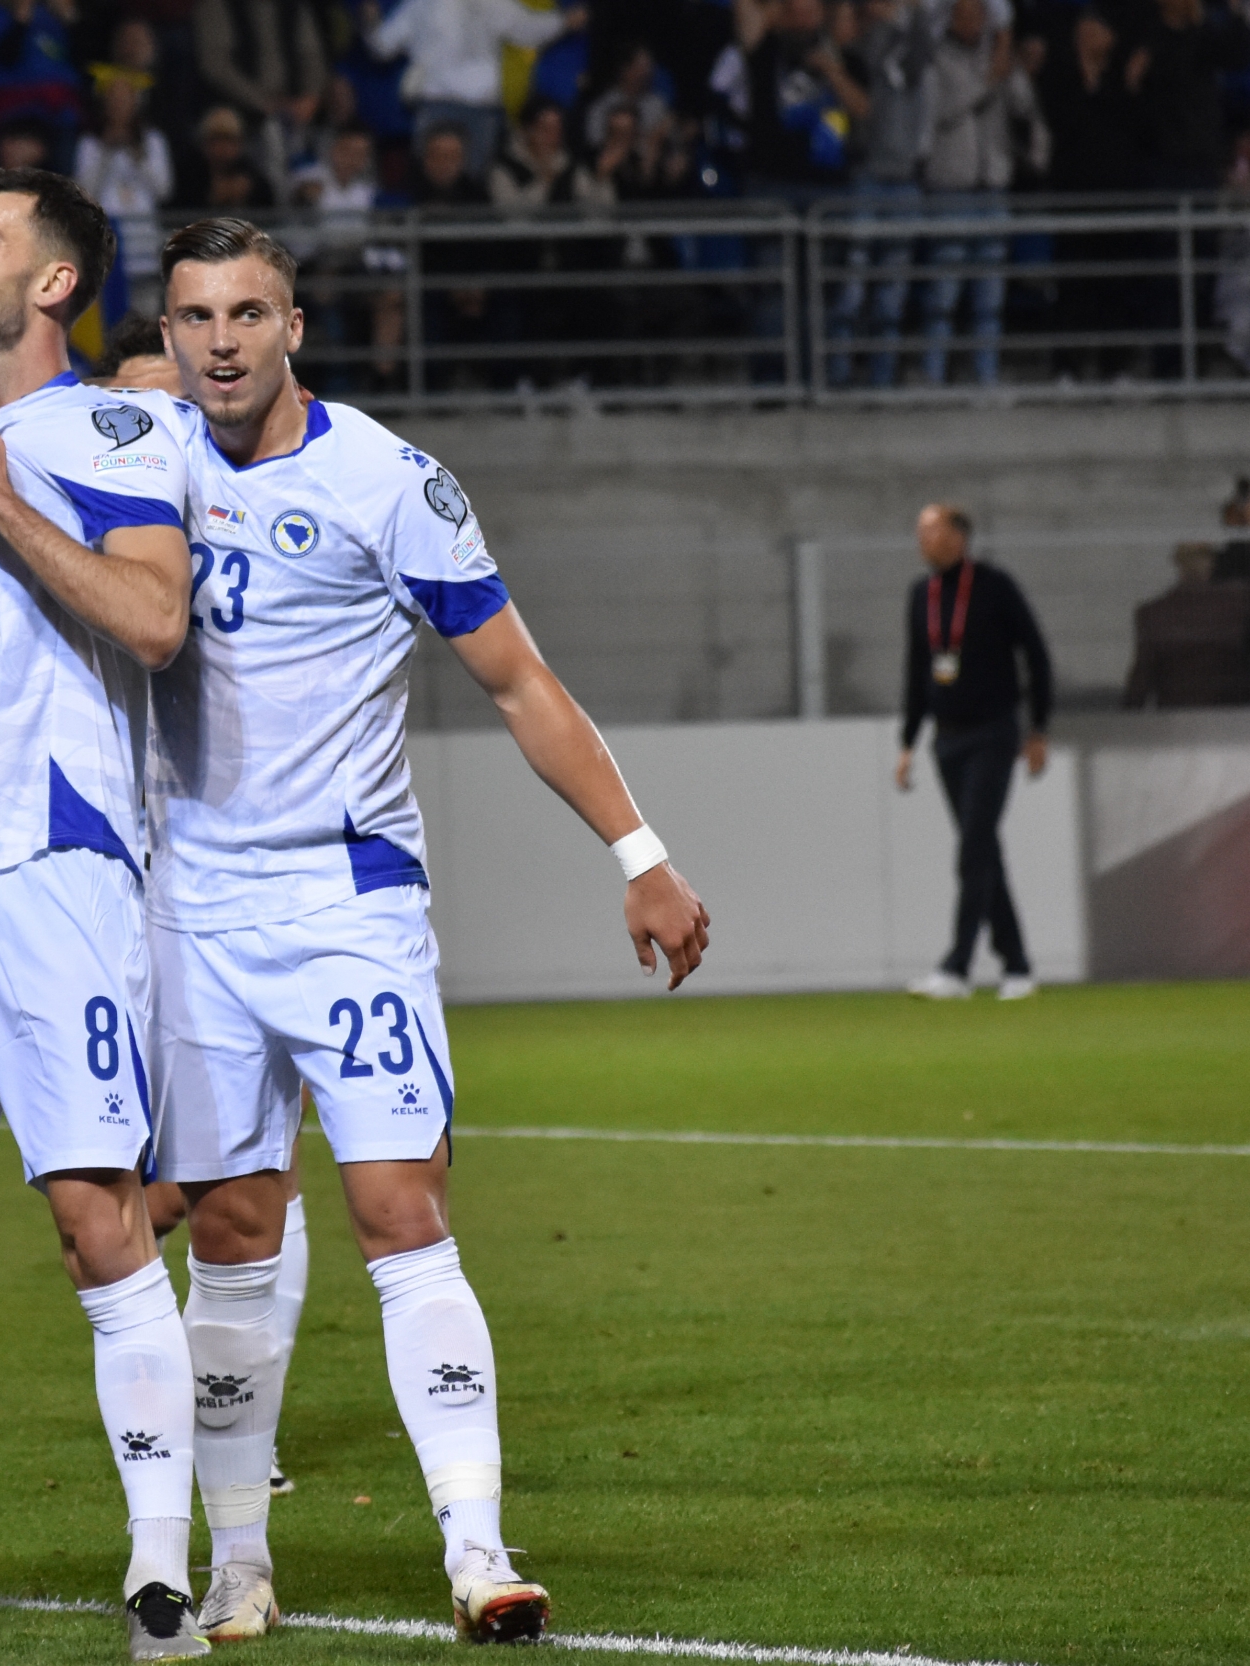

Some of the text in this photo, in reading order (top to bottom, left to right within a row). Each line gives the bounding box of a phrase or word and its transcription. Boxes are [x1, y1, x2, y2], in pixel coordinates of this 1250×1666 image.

[93, 455, 167, 470] FOUNDATION
[189, 542, 250, 634] 23
[84, 995, 120, 1081] 8
[328, 991, 415, 1079] 23
[391, 1107, 429, 1116] KELME
[99, 1115, 131, 1126] KELME
[428, 1383, 485, 1396] KELME
[195, 1391, 254, 1409] KELME
[123, 1450, 171, 1462] KELME
